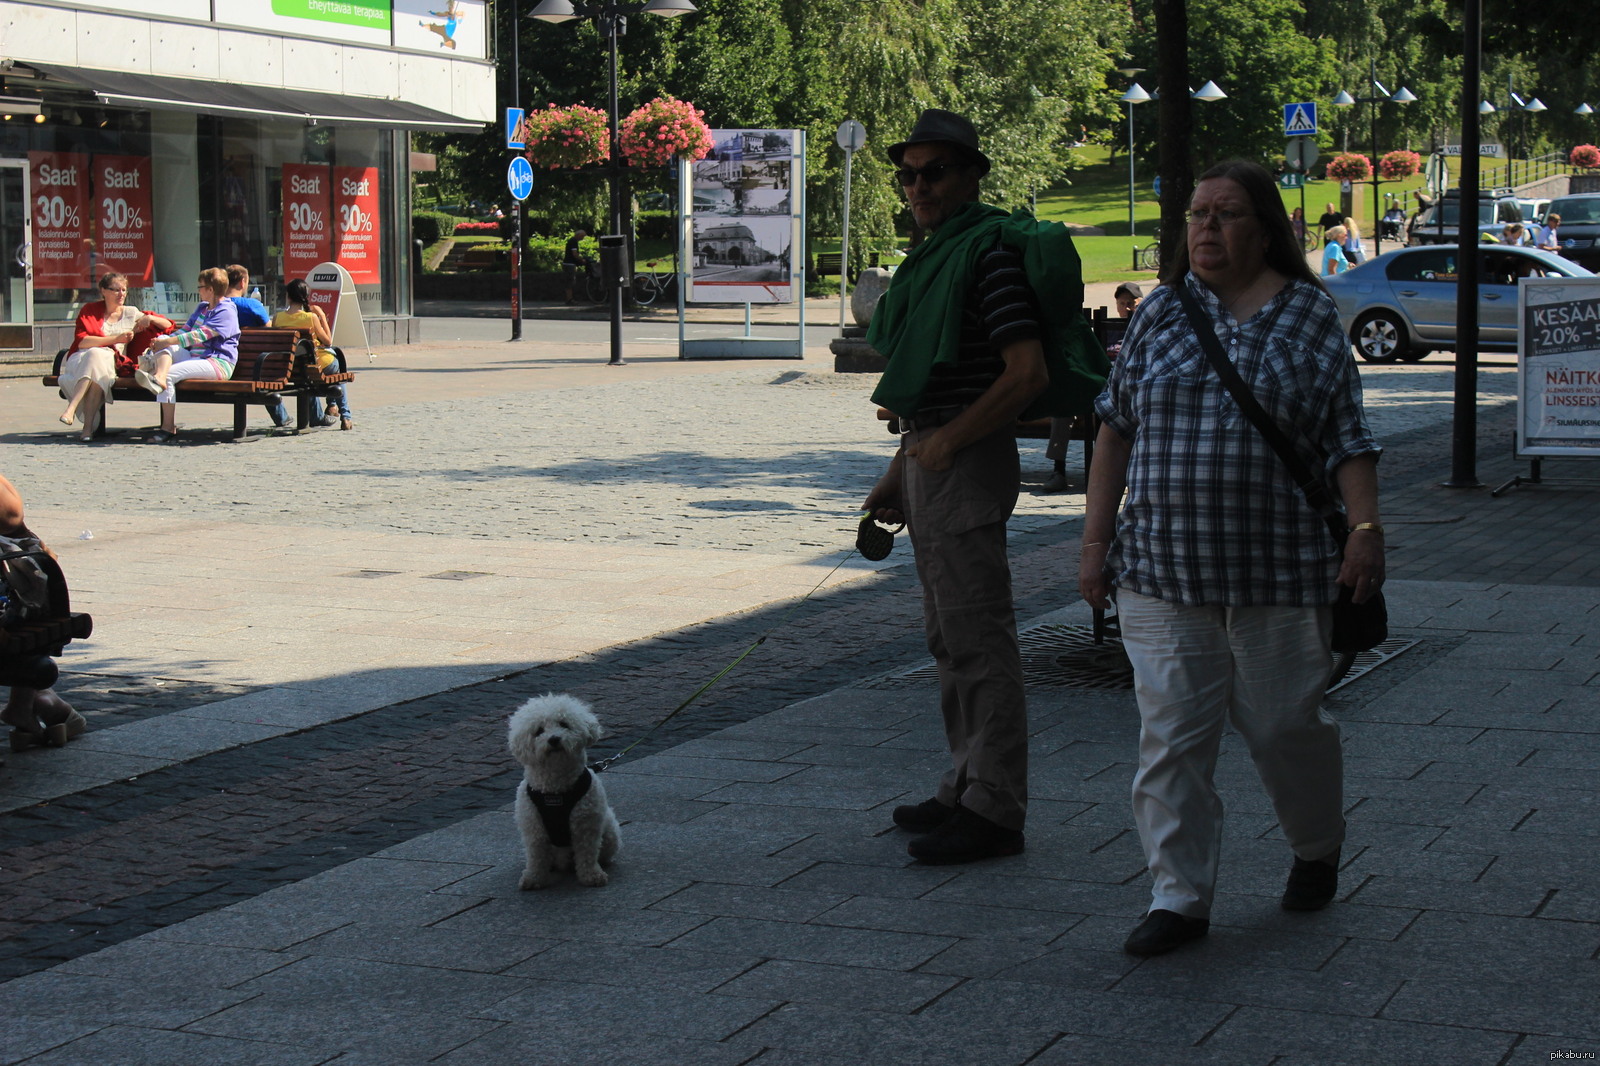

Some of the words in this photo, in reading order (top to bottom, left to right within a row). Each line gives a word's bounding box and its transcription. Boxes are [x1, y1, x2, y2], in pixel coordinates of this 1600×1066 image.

[40, 164, 77, 186] Saat
[104, 167, 140, 188] Saat
[291, 175, 320, 194] Saat
[342, 178, 370, 196] Saat
[37, 195, 80, 228] 30%
[102, 197, 143, 230] 30%
[290, 202, 324, 231] 30%
[340, 204, 373, 232] 30%
[39, 240, 70, 249] punaisesta
[103, 241, 134, 250] punaisesta
[290, 241, 316, 250] punaisesta
[341, 242, 365, 251] punaisesta
[38, 250, 74, 260] hintalapusta
[103, 250, 138, 260] hintalapusta
[290, 250, 319, 259] hintalapusta
[341, 250, 367, 259] hintalapusta
[311, 292, 332, 303] Saat
